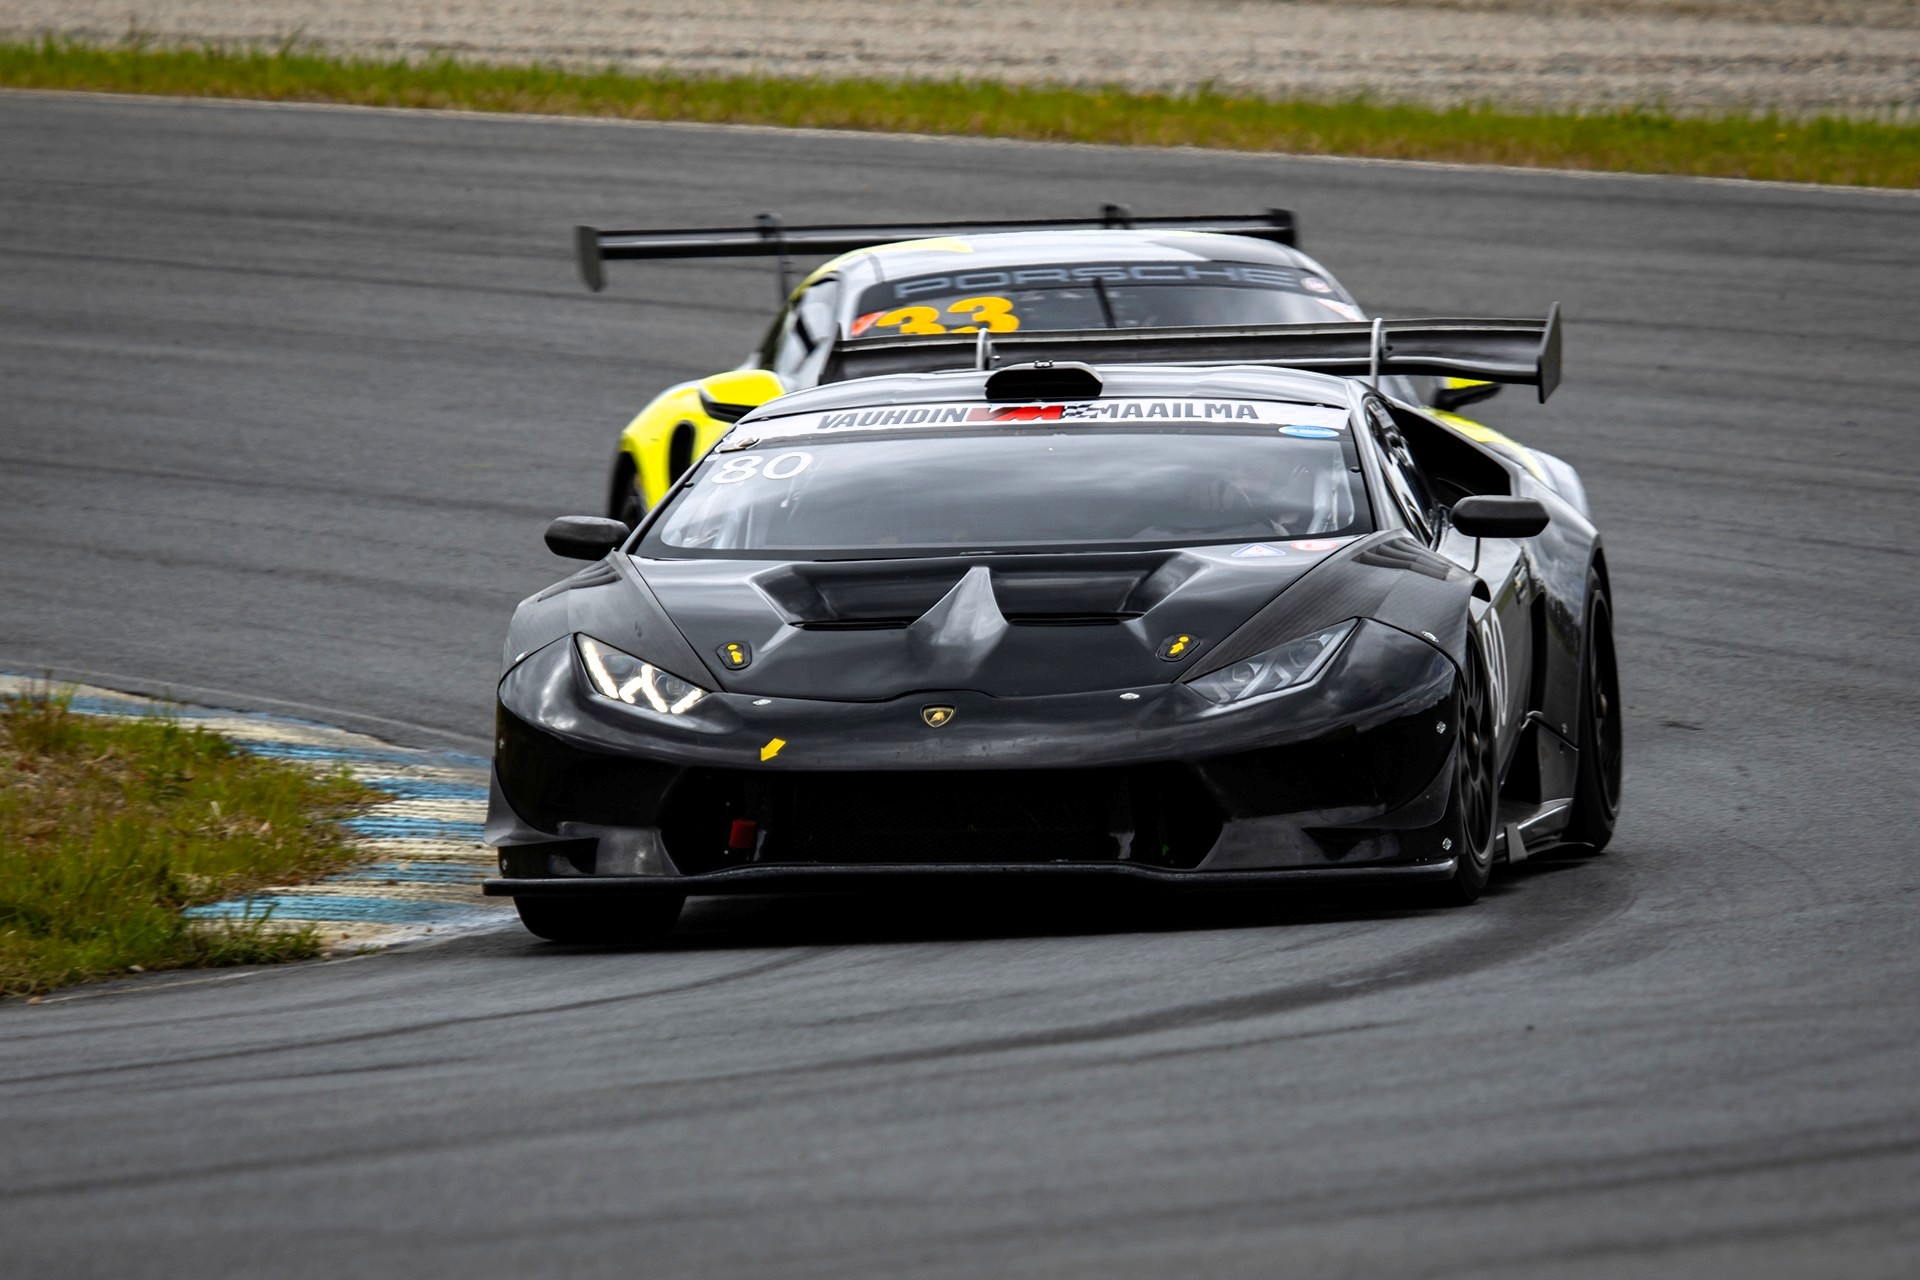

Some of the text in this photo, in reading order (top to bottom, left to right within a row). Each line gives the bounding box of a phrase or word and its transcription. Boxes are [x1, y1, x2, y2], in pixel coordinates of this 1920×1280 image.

[895, 265, 1298, 298] PORSCHE
[876, 296, 1020, 334] 33
[817, 407, 969, 429] VAUHDIN
[1089, 403, 1260, 419] MAAILMA
[711, 451, 814, 484] 80
[1482, 607, 1508, 738] 80
